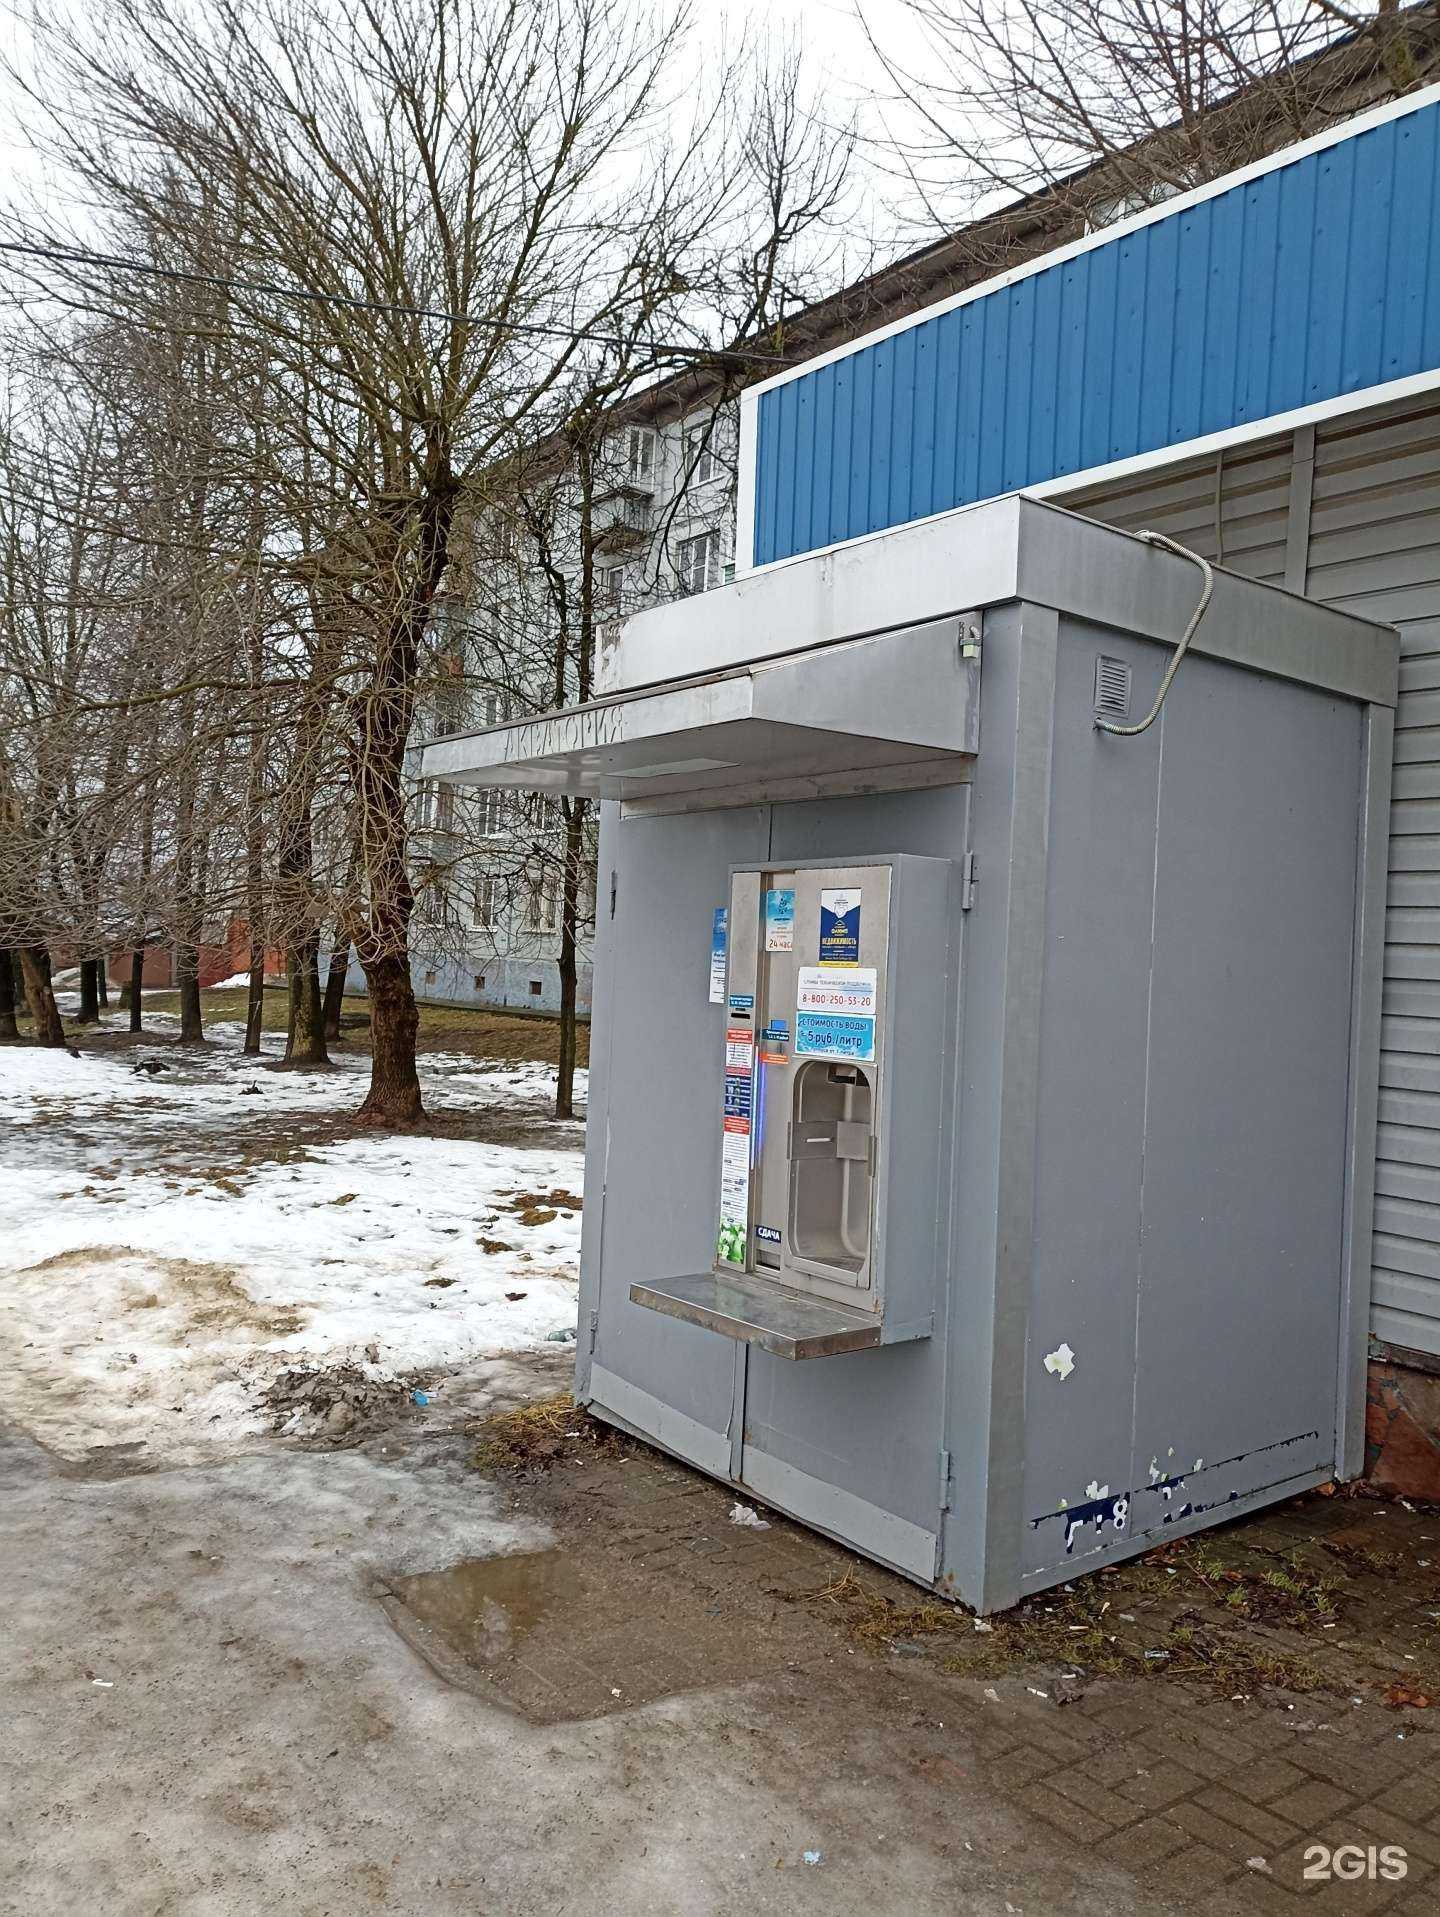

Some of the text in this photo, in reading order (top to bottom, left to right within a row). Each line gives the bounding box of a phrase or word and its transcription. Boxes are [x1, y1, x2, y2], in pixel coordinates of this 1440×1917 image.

[504, 705, 624, 760] АКВАТОРИЯ
[769, 938, 778, 949] 24
[802, 993, 871, 1006] 8-800-250-53-20
[757, 1227, 780, 1241] СДАЧА
